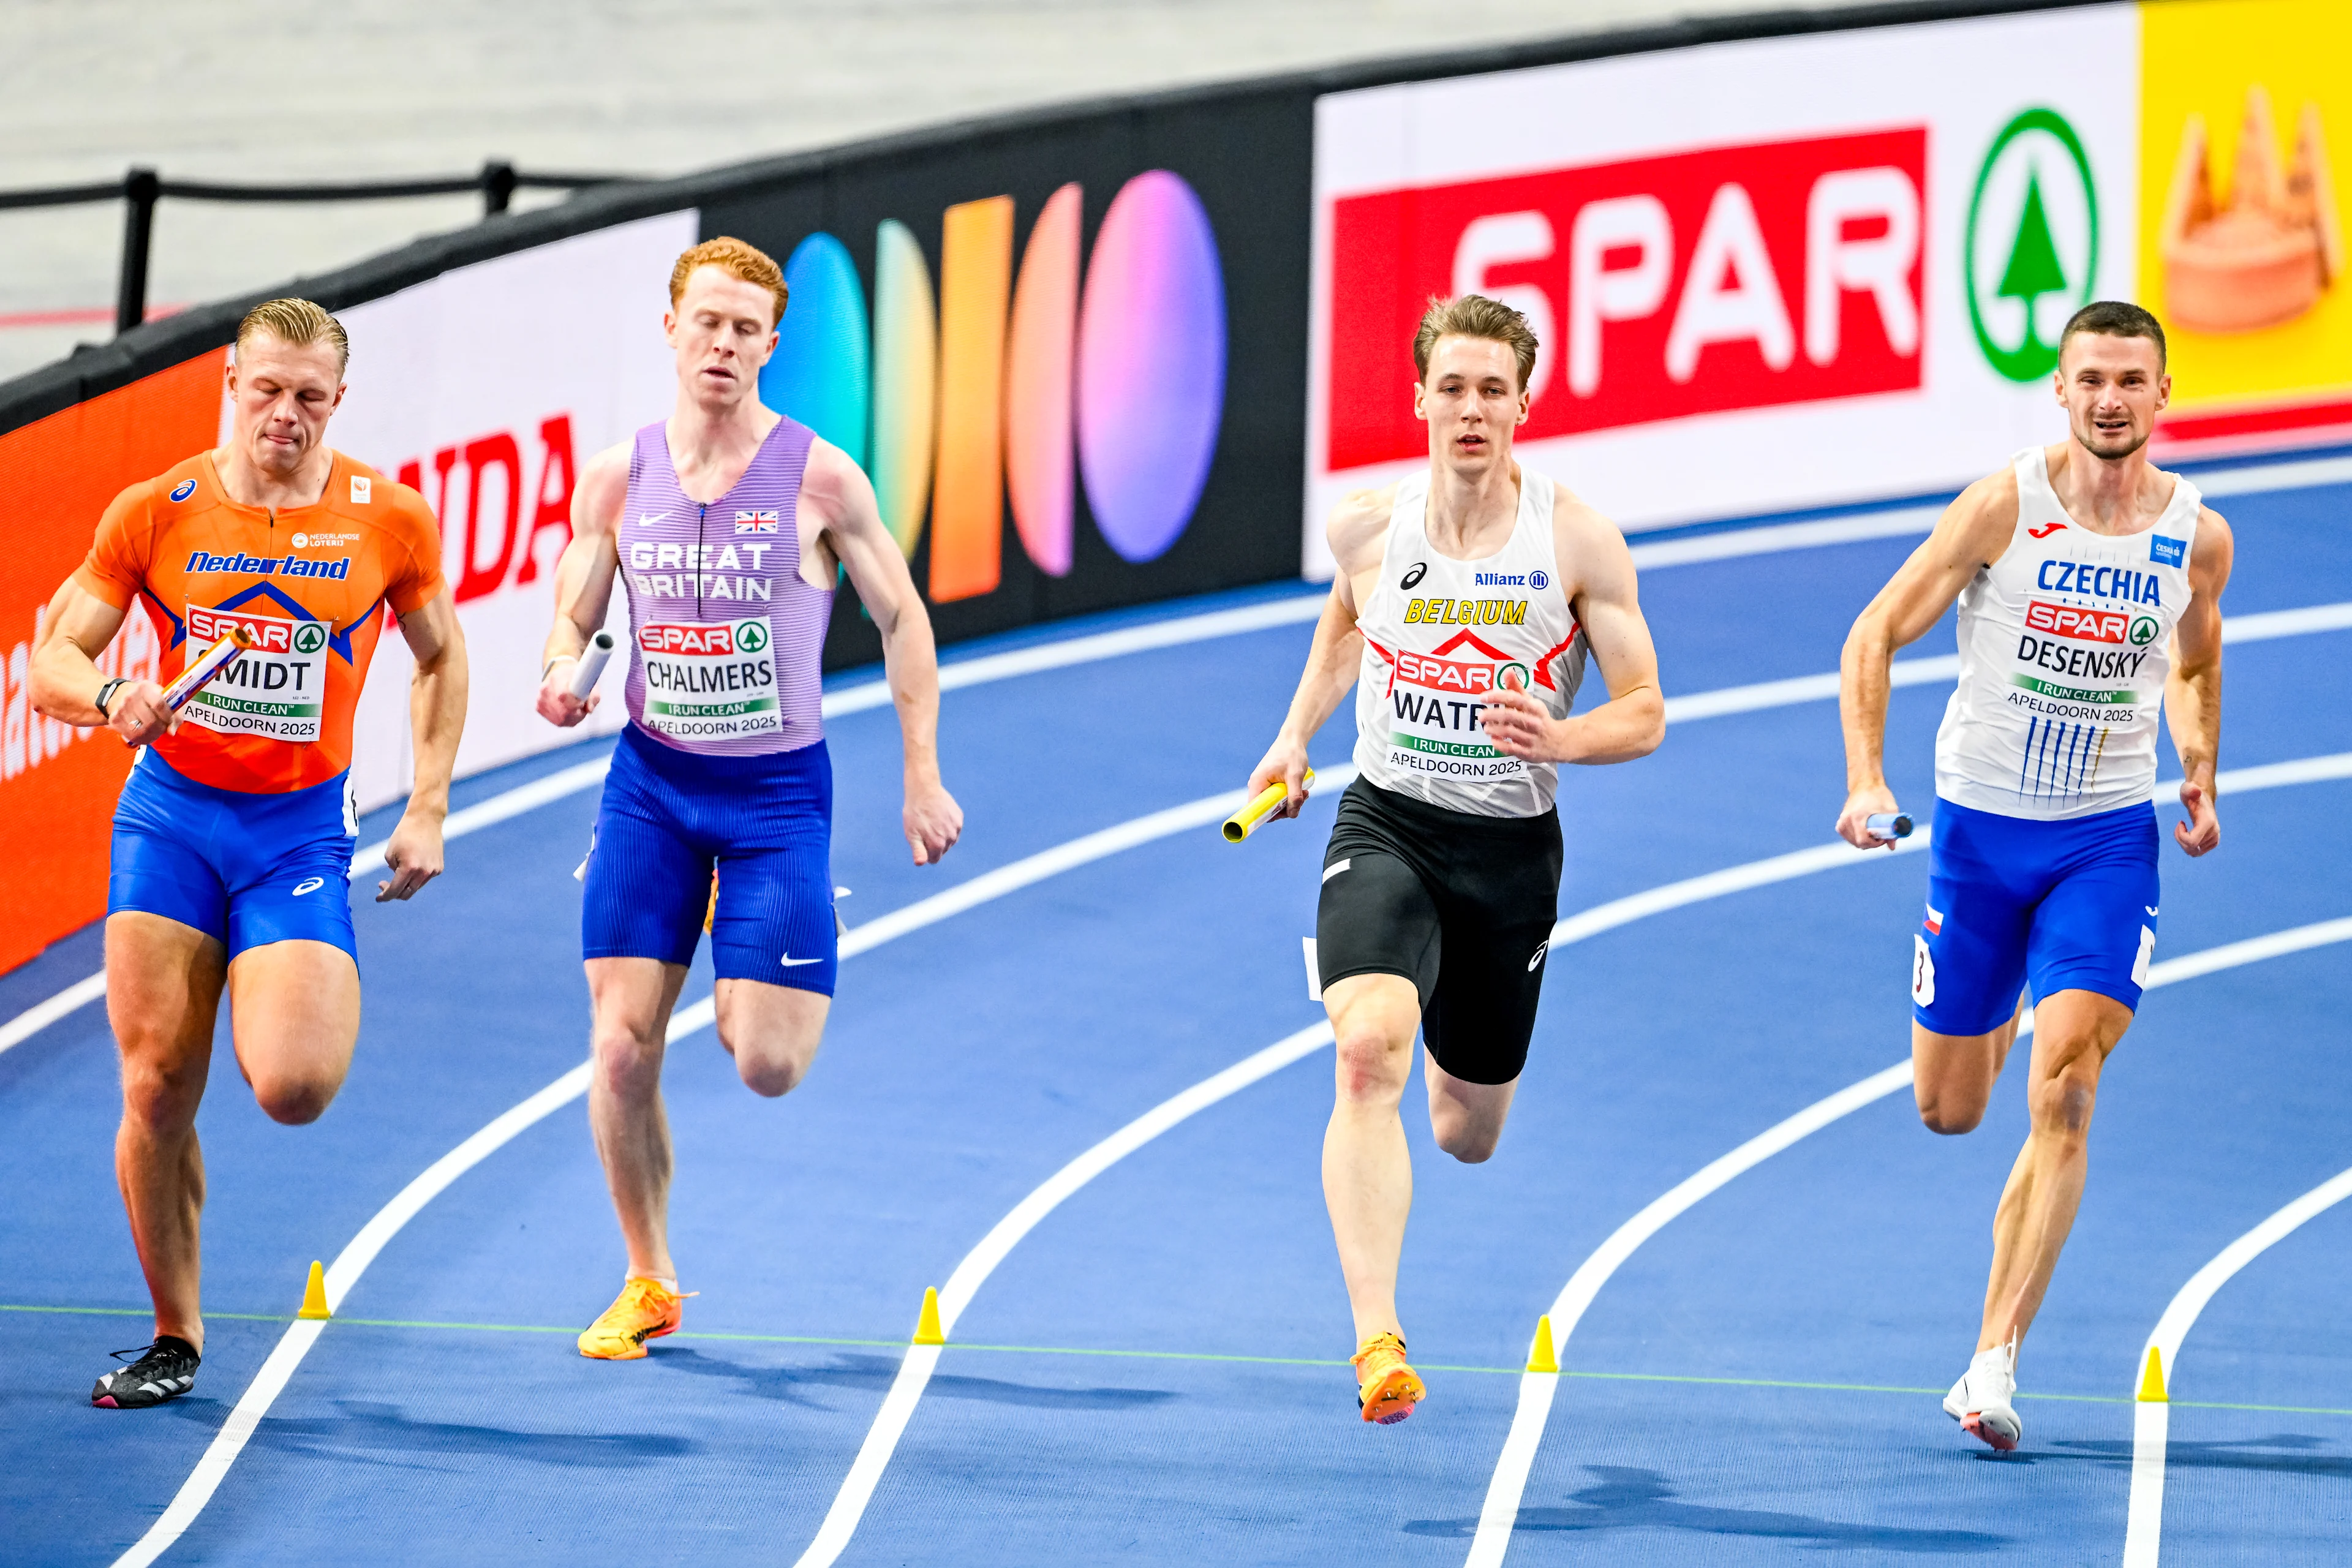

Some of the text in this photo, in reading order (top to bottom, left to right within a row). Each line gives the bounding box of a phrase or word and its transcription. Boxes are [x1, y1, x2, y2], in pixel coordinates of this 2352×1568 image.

[1451, 165, 1920, 405] SPAR
[630, 542, 771, 570] GREAT
[633, 573, 772, 601] BRITAIN
[1475, 573, 1525, 586] Allianz
[2037, 560, 2160, 607] CZECHIA
[1403, 598, 1528, 625] BELGIUM
[2029, 605, 2125, 640] SPAR
[192, 613, 288, 649] SPAR
[640, 627, 731, 652] SPAR
[2018, 635, 2148, 678] DESENSKÝ
[647, 660, 772, 693] CHALMERS
[1399, 655, 1491, 690] SPAR
[207, 694, 211, 704] I
[214, 696, 240, 710] RUN
[2037, 680, 2042, 692] I
[2043, 684, 2071, 698] RUN
[185, 706, 315, 735] APELDOORN 2025
[668, 704, 672, 714] I
[674, 705, 699, 716] RUN
[2008, 692, 2133, 722] APELDOORN 2025
[648, 716, 776, 734] APELDOORN 2025
[1414, 738, 1495, 756] I RUN CLEAN
[1390, 752, 1521, 776] APELDOORN 2025
